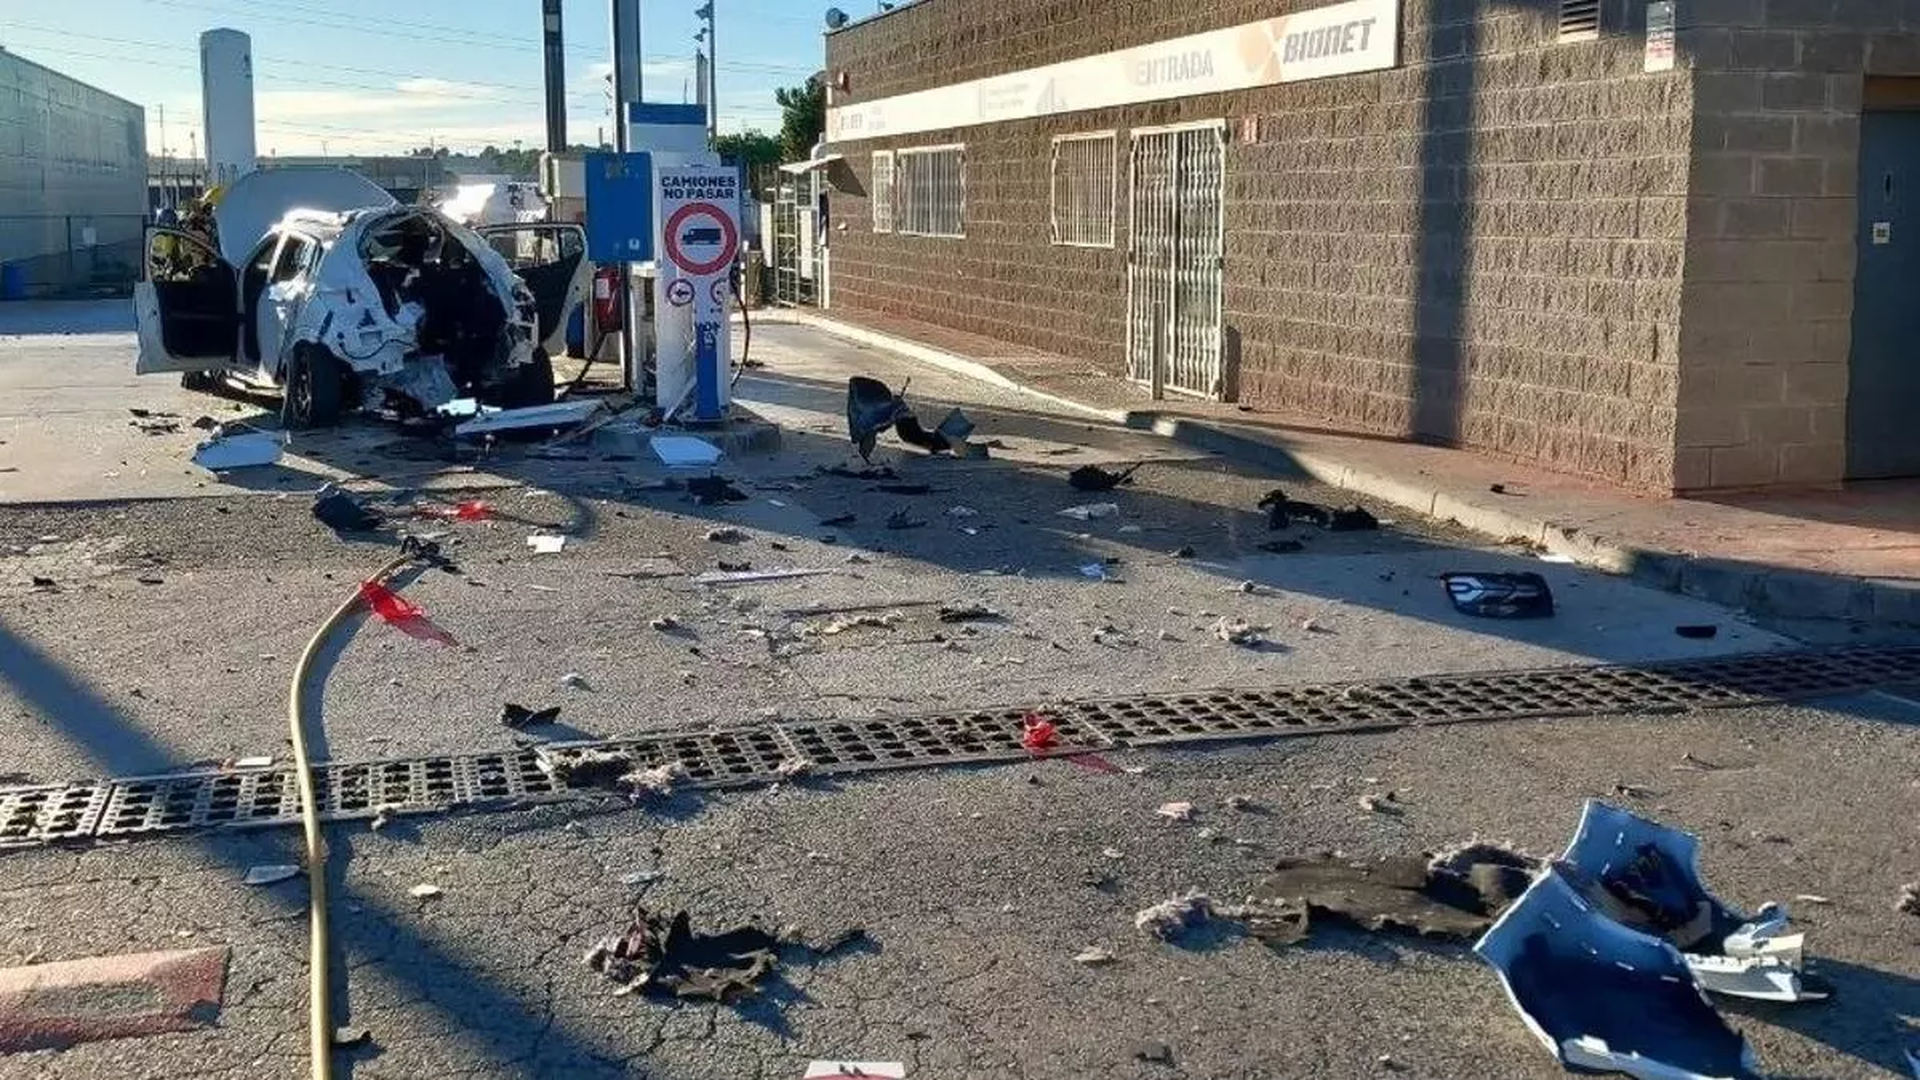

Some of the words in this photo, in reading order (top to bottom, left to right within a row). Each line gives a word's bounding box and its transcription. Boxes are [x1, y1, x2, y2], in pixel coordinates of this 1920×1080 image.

[1137, 48, 1215, 86] ENTRADA
[661, 175, 736, 188] CAMIONES
[663, 188, 684, 200] NO
[686, 188, 734, 200] PASAR
